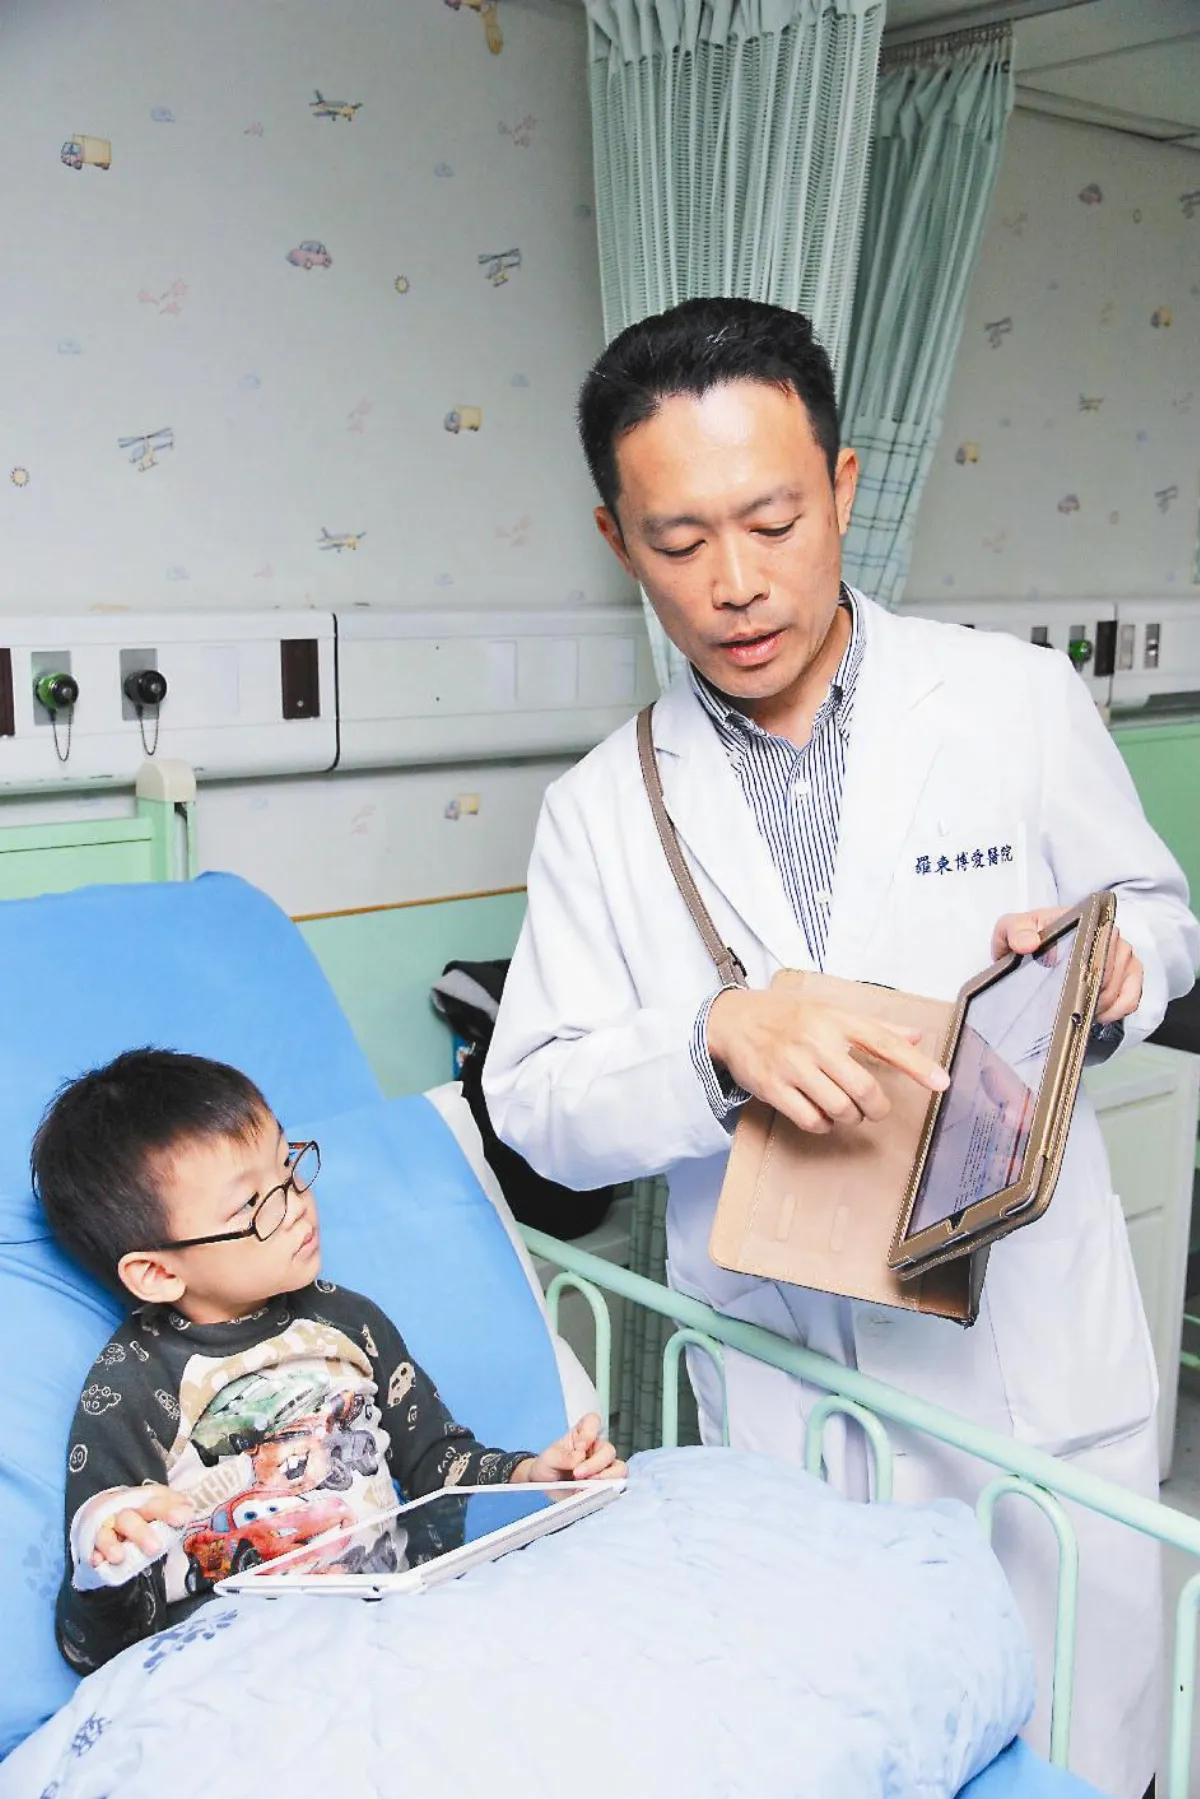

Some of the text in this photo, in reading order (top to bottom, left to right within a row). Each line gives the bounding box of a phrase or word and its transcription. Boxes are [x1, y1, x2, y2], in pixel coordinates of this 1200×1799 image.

[915, 844, 1014, 876] 羅東博愛醫院
